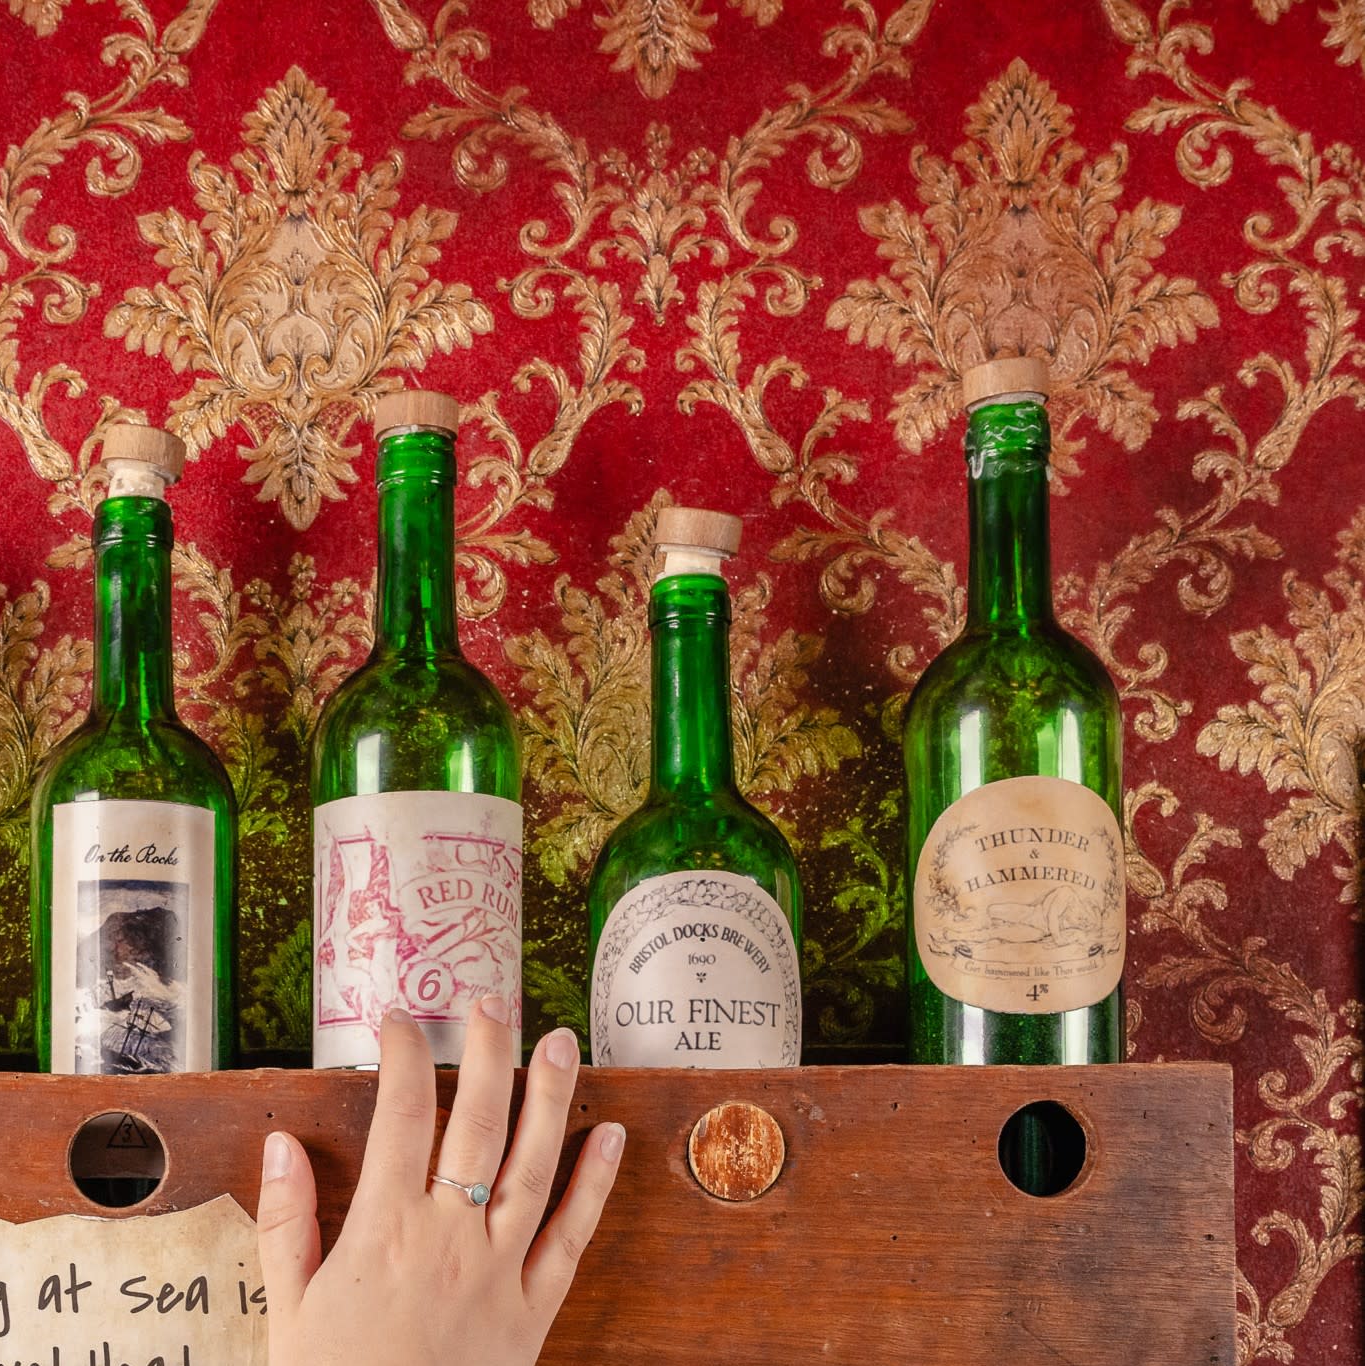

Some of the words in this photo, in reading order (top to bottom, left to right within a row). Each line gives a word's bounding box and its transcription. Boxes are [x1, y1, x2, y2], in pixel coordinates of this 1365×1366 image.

[975, 827, 1090, 853] THUNDER
[84, 844, 105, 864] On
[106, 844, 132, 863] the
[135, 843, 179, 866] Rocks
[1029, 849, 1040, 860] &
[965, 866, 1096, 892] HAMMERED
[417, 878, 474, 910] RED
[629, 933, 671, 974] BRISTOL
[673, 923, 719, 939] DOCKS
[721, 927, 772, 974] BREWERY
[1034, 966, 1050, 976] like
[417, 969, 441, 1002] 6
[1025, 983, 1049, 1001] 4%
[615, 1000, 676, 1028] OUR
[688, 998, 781, 1027] FINEST
[674, 1031, 722, 1051] ALE
[37, 1259, 93, 1313] at
[237, 1261, 268, 1316] is
